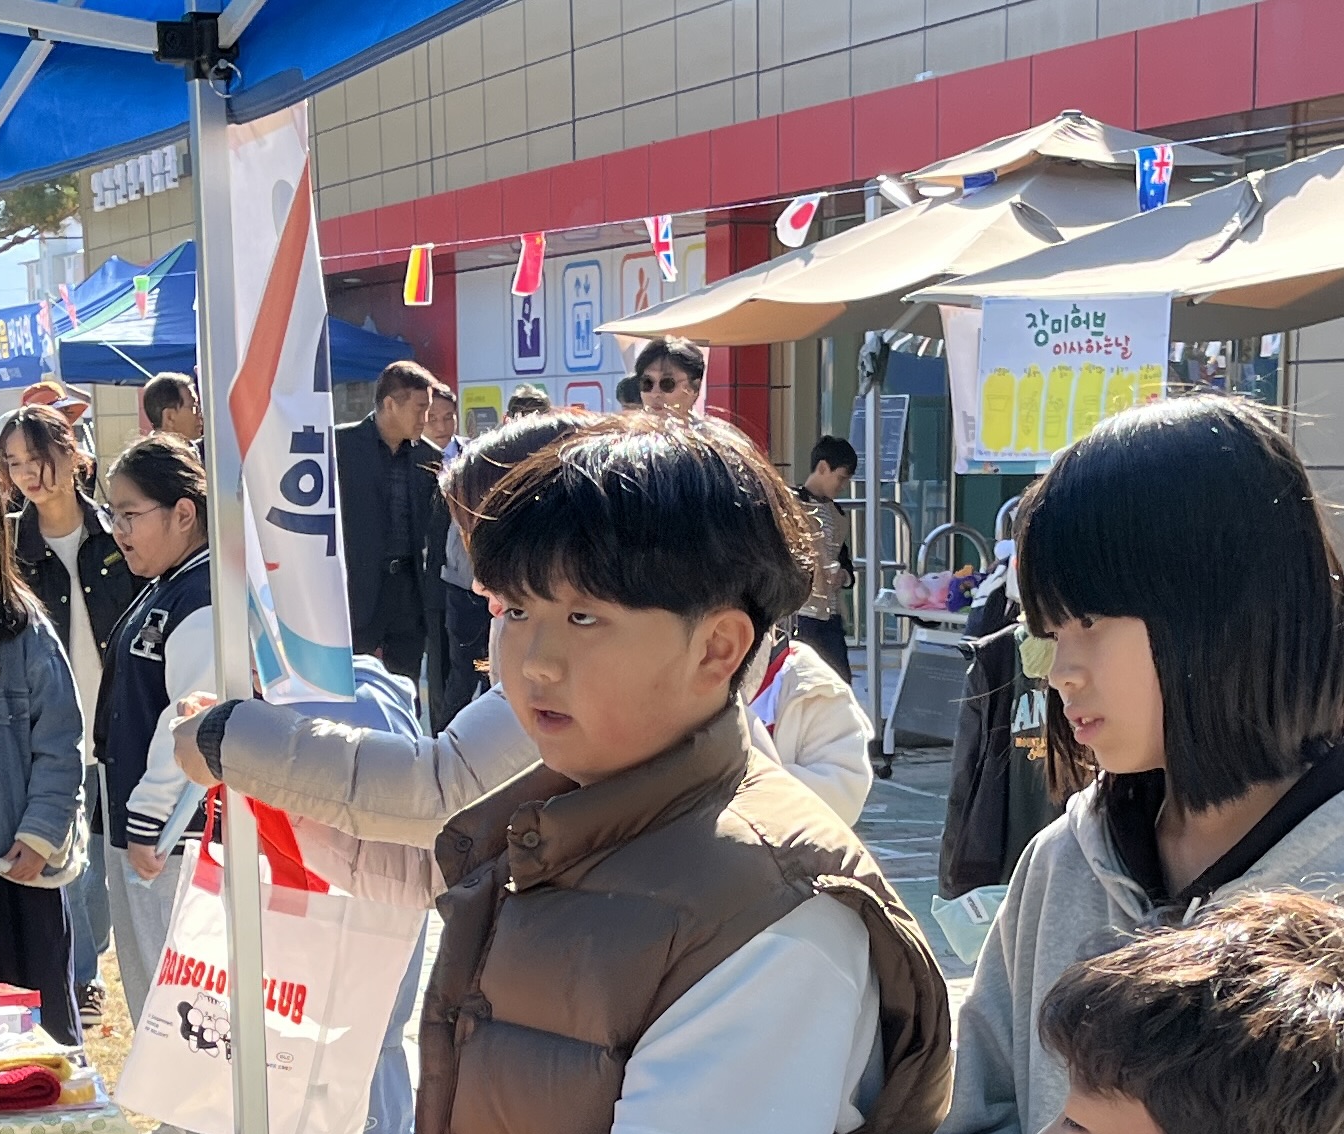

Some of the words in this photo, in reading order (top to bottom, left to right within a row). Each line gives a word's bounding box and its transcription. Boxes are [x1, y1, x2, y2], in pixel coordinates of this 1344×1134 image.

[1026, 304, 1106, 347] 장미허브
[157, 947, 206, 988] DAISO
[263, 977, 307, 1025] LUB
